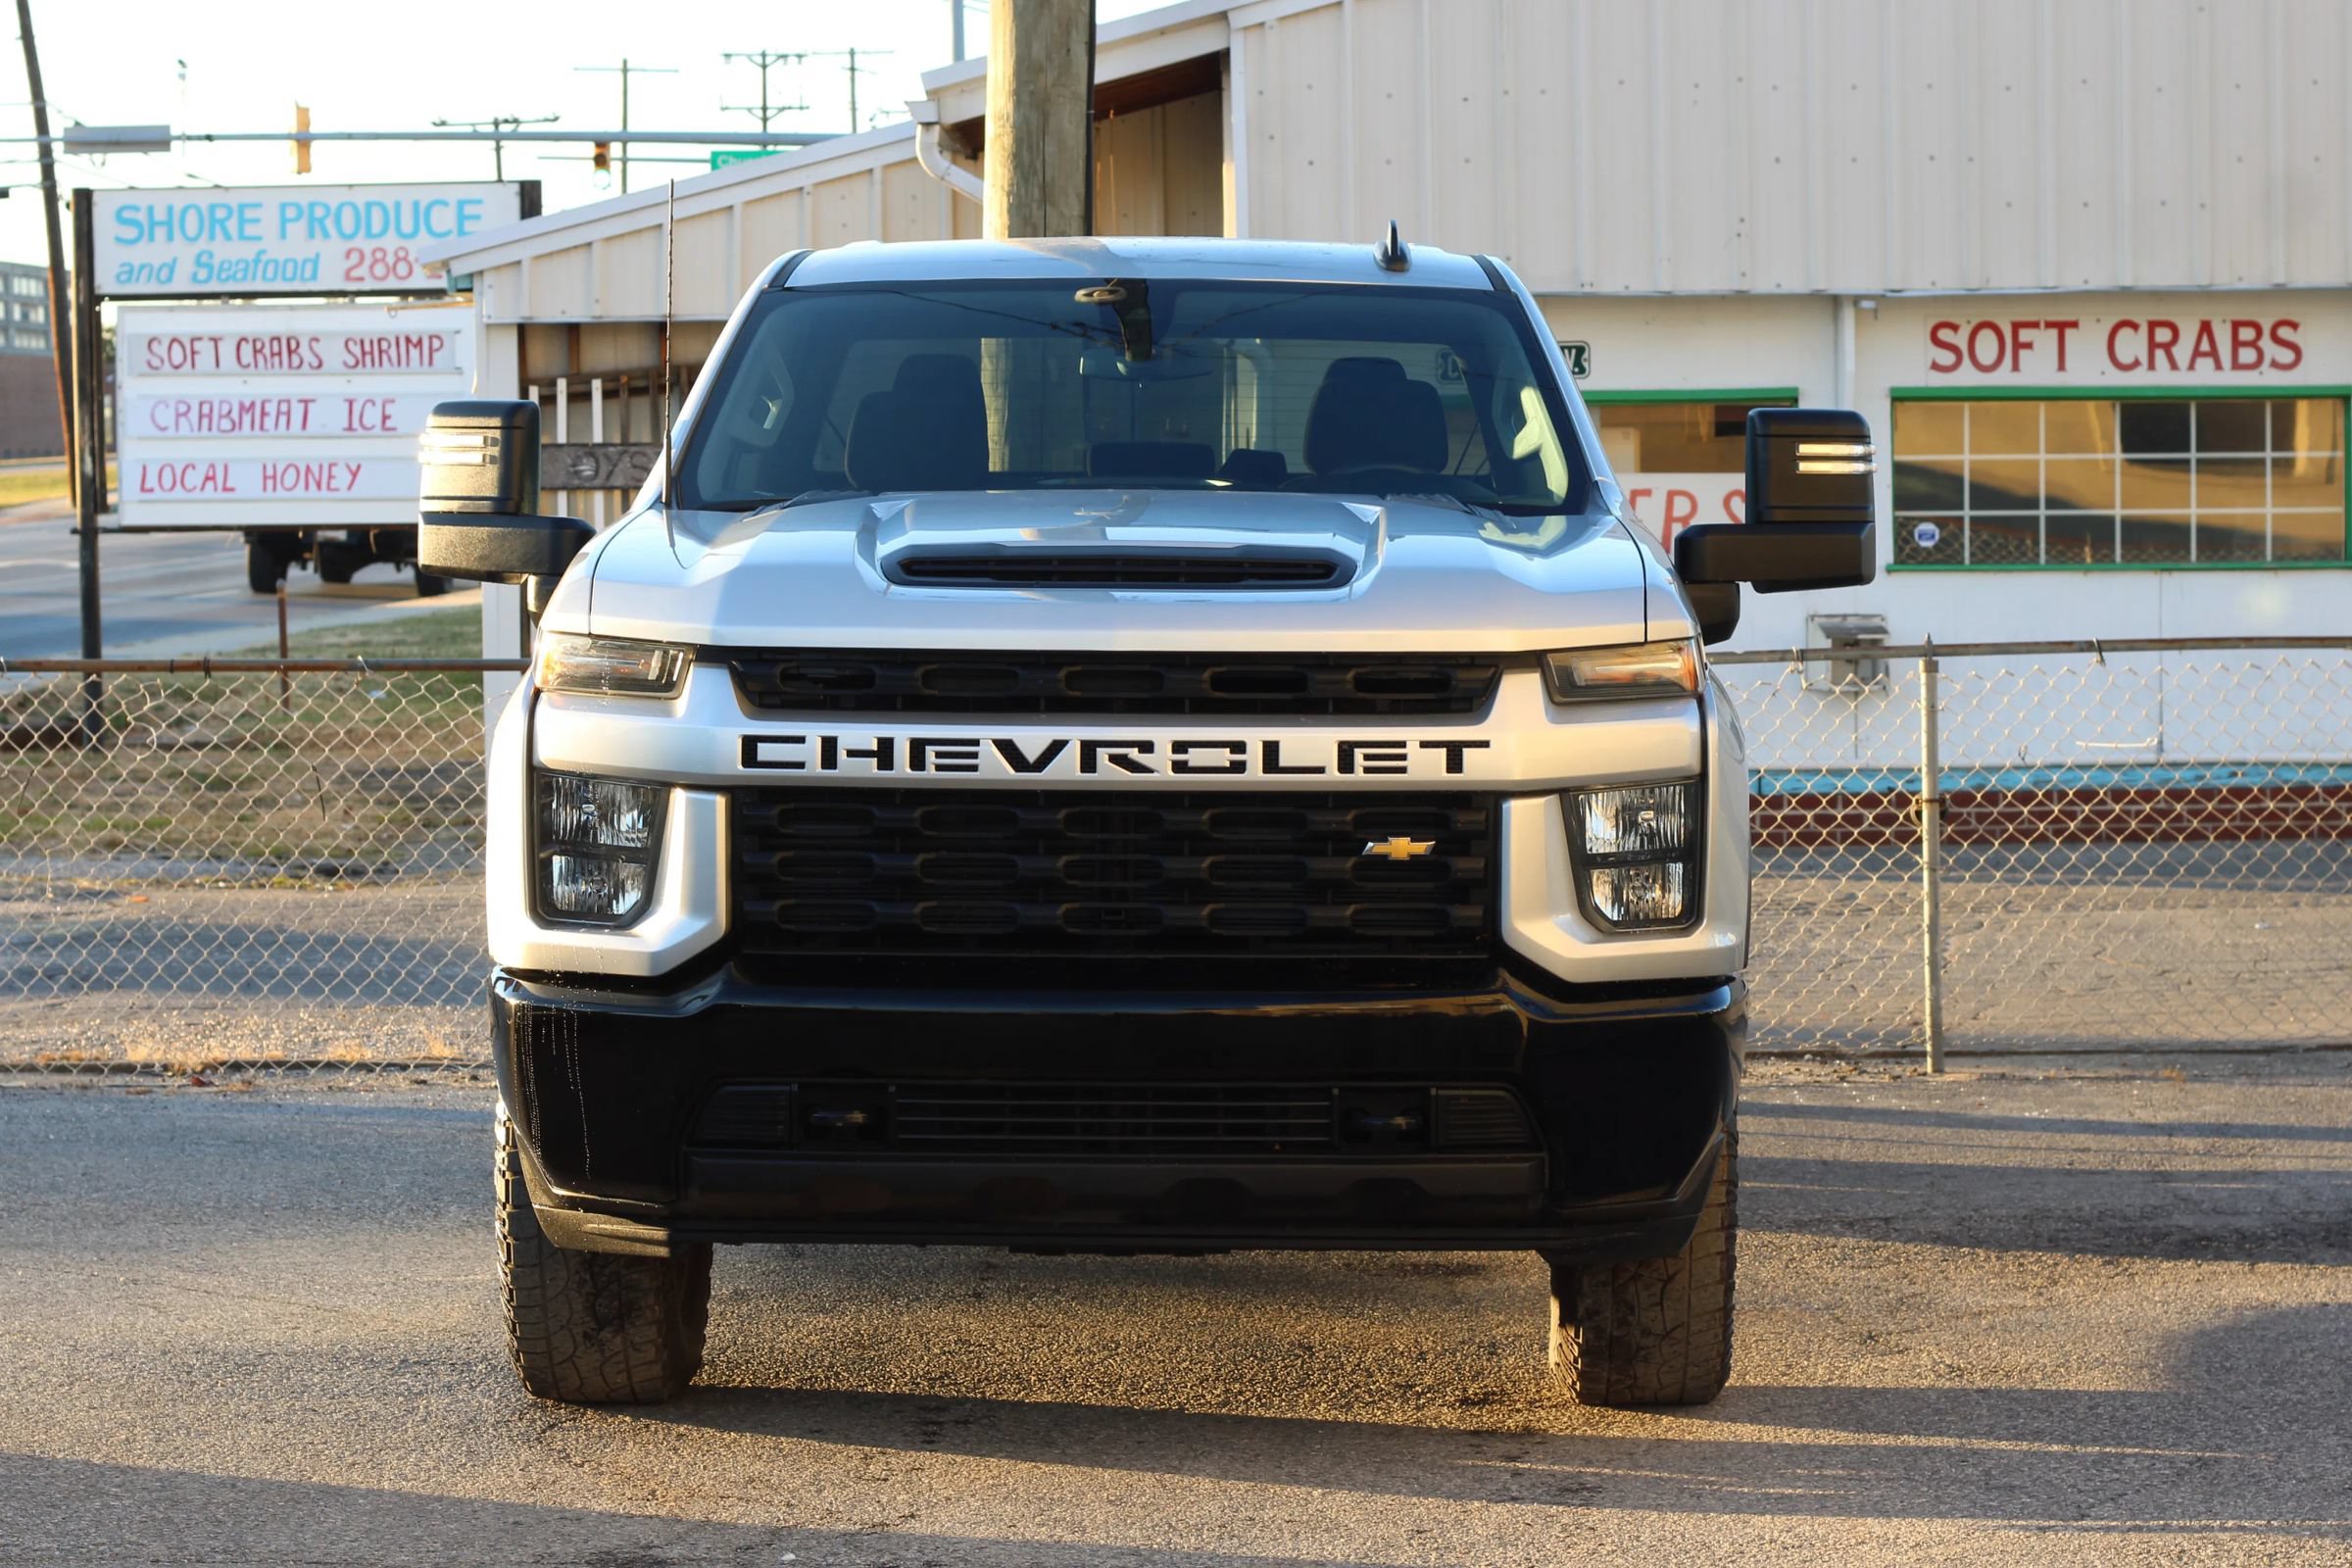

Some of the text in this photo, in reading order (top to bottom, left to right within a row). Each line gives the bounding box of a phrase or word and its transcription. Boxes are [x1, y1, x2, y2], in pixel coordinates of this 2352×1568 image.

[114, 198, 484, 246] SHORE PRODUCE
[115, 248, 320, 285] and Seafood
[146, 333, 445, 371] SOFT CRABS SHRIMP
[1929, 318, 2303, 373] SOFT CRABS
[150, 398, 398, 434] CRABMEAT ICE
[139, 462, 362, 494] LOCAL HONEY
[739, 733, 1491, 775] CHEVROLET
